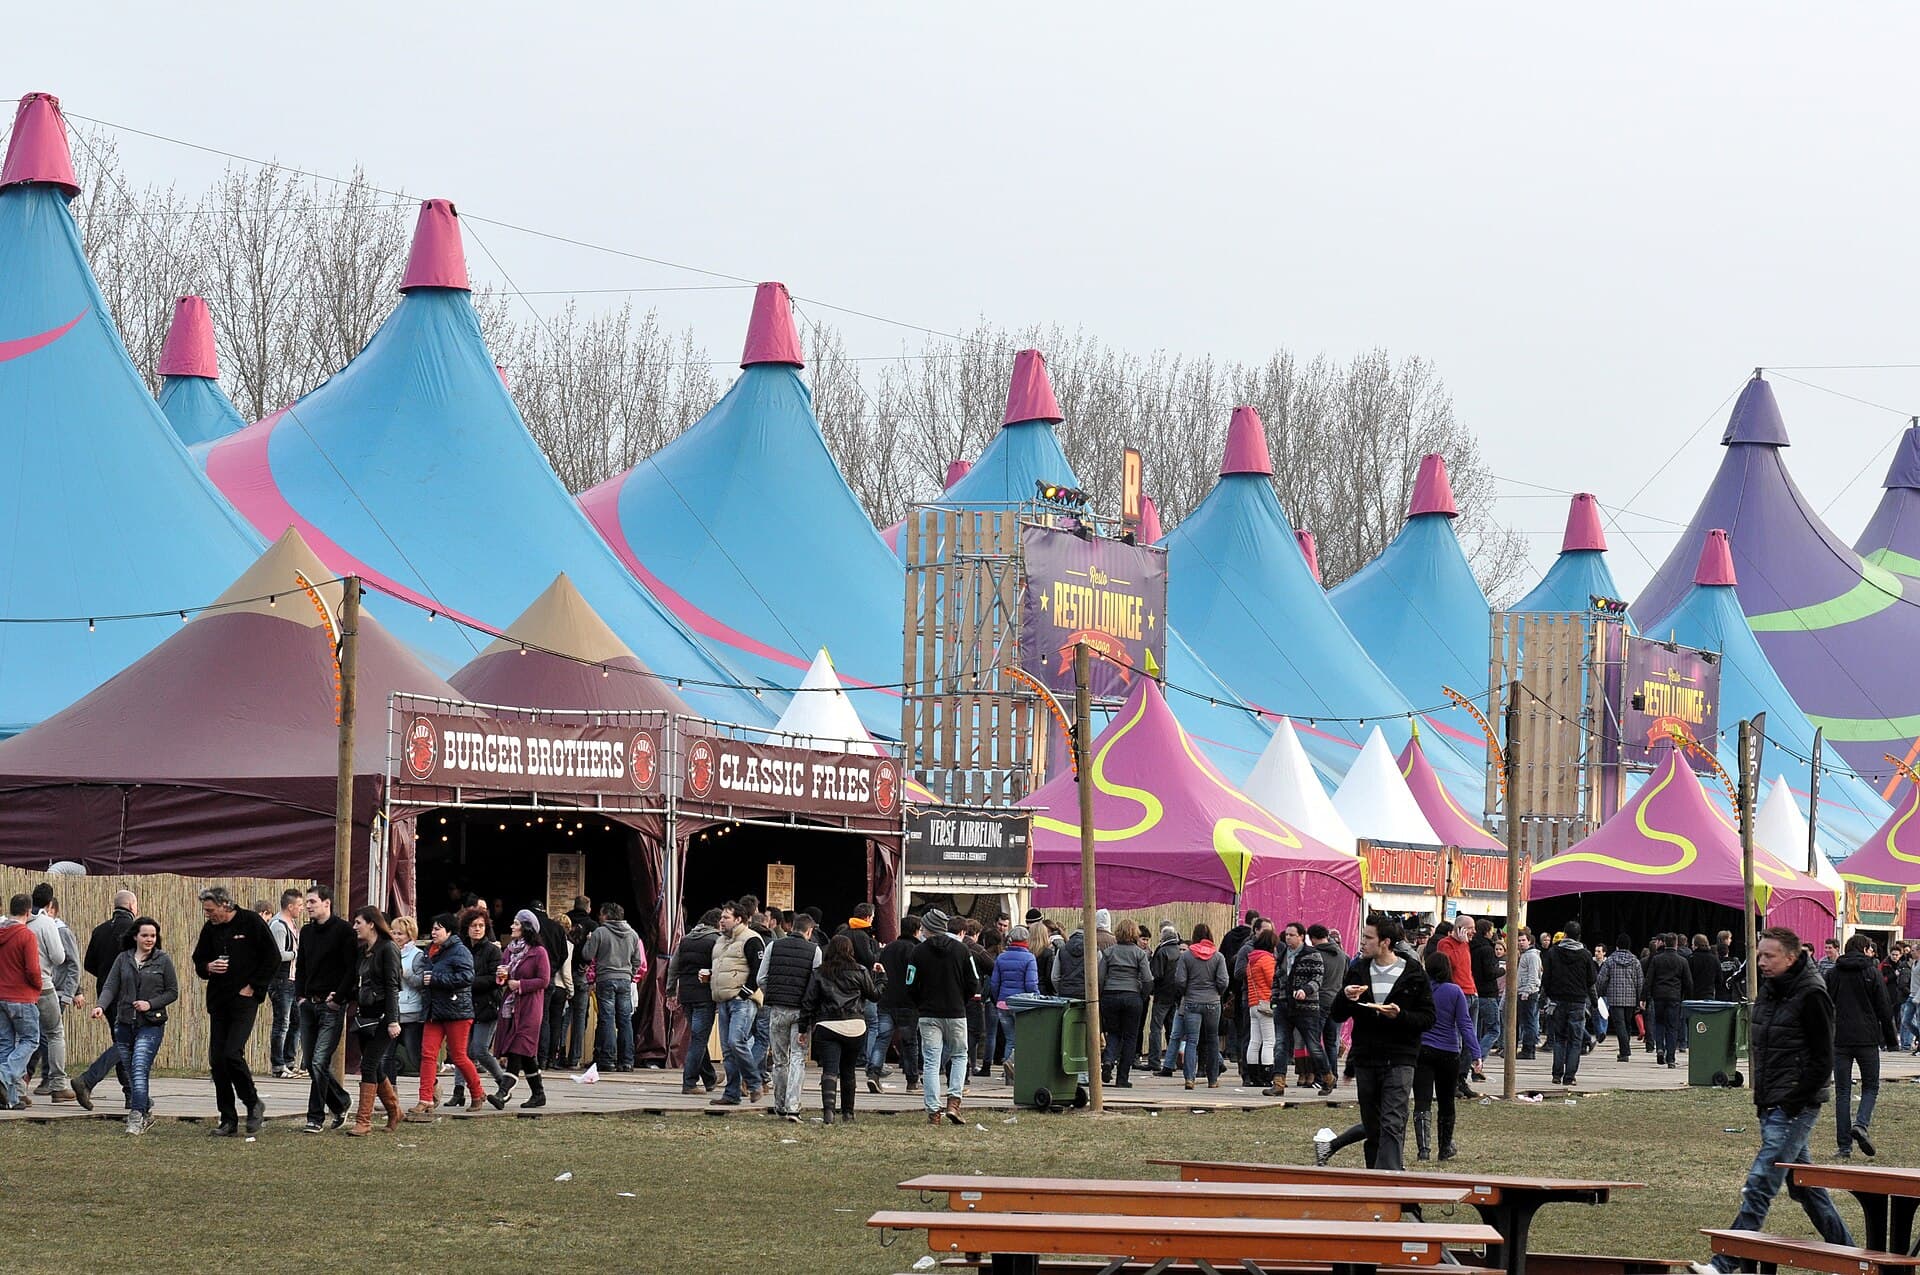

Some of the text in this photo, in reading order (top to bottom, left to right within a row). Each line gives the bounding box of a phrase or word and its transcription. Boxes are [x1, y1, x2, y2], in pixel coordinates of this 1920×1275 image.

[1124, 450, 1140, 515] R
[1053, 581, 1143, 640] RESTO LOUNGE
[1643, 680, 1704, 724] RESTO LOUNGE
[443, 730, 624, 779] BURGER BROTHERS
[719, 753, 870, 802] CLASSIC FRIES
[930, 819, 1003, 848] VERSE KIBBELING
[1371, 846, 1437, 887] MERCHANDISE
[1461, 853, 1523, 893] MERCHANDE
